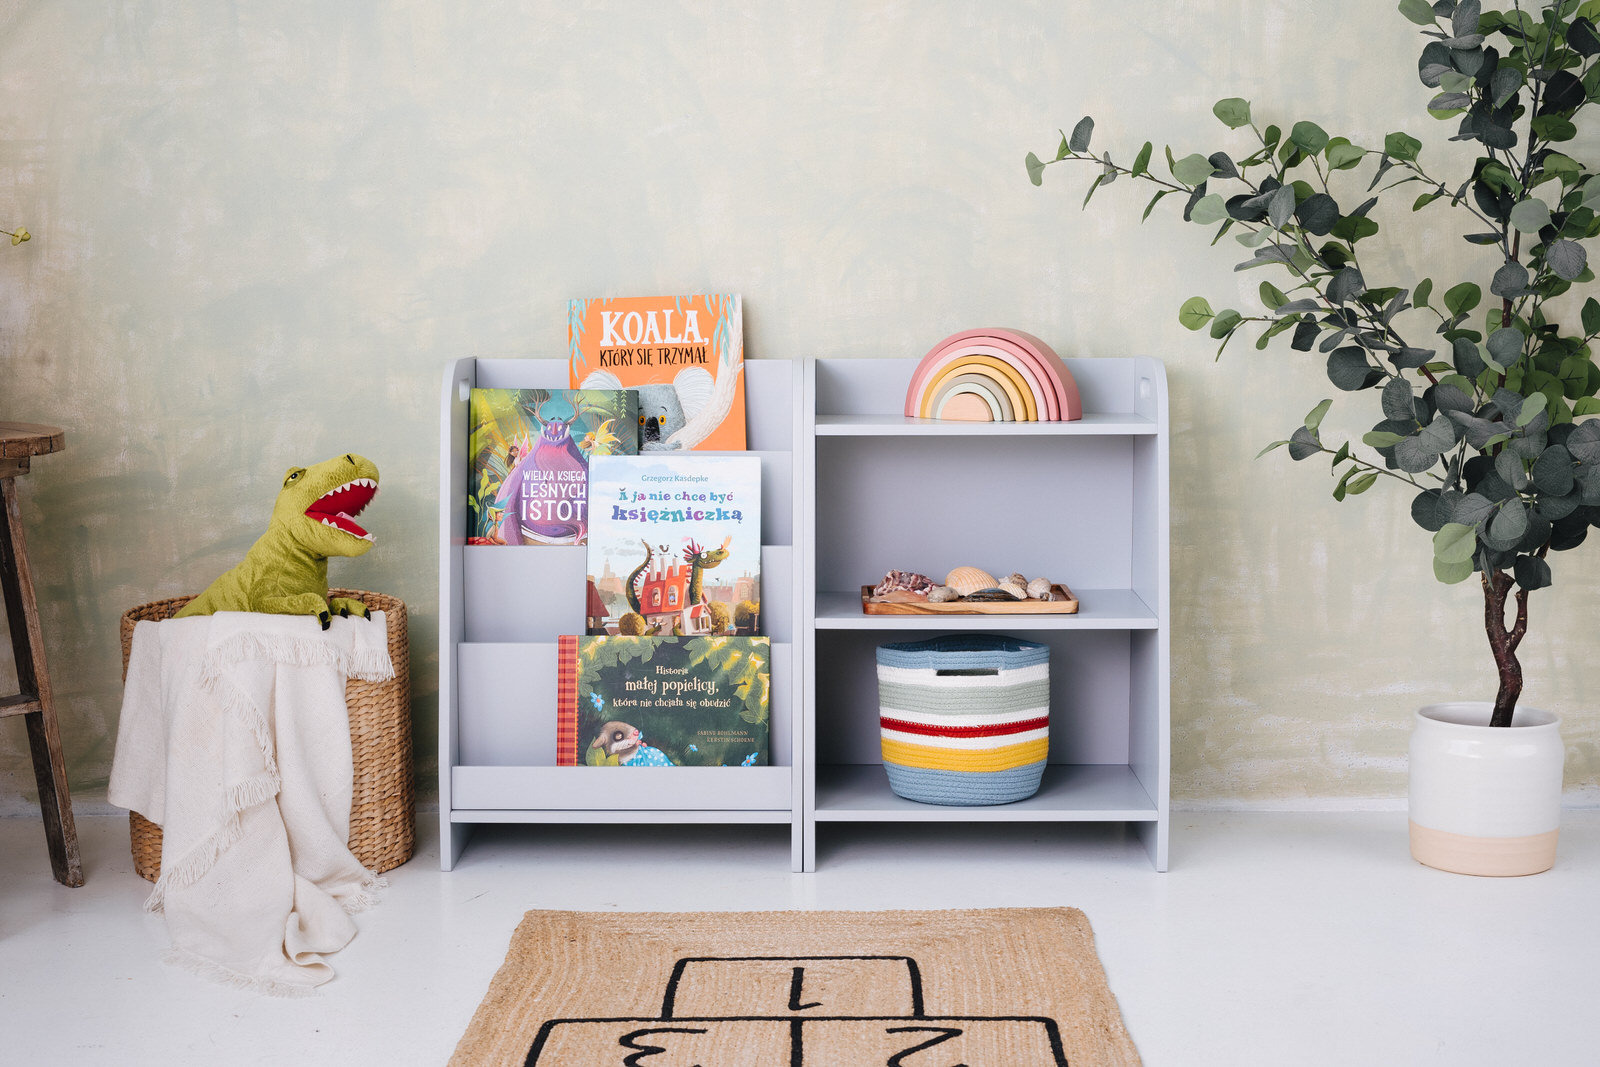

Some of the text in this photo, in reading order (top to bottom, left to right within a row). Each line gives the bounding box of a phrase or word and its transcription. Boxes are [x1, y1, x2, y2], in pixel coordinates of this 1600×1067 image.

[600, 309, 709, 346] KOALA,
[600, 346, 709, 367] KTÓRY SIĘ TRZYMAŁ
[522, 470, 587, 483] WIELKA KSIĘGA
[641, 474, 709, 483] Grzegorz Kasdepke
[522, 480, 587, 498] LEŚNYCH
[631, 491, 646, 503] ja
[648, 491, 671, 501] nie
[674, 491, 706, 503] chcę
[709, 491, 734, 503] być
[521, 500, 587, 521] ISTOT
[611, 505, 743, 524] księżniczką
[656, 665, 689, 675] Historia
[625, 676, 719, 695] małej popielicy,
[612, 697, 731, 709] która nie chciała się obudzić
